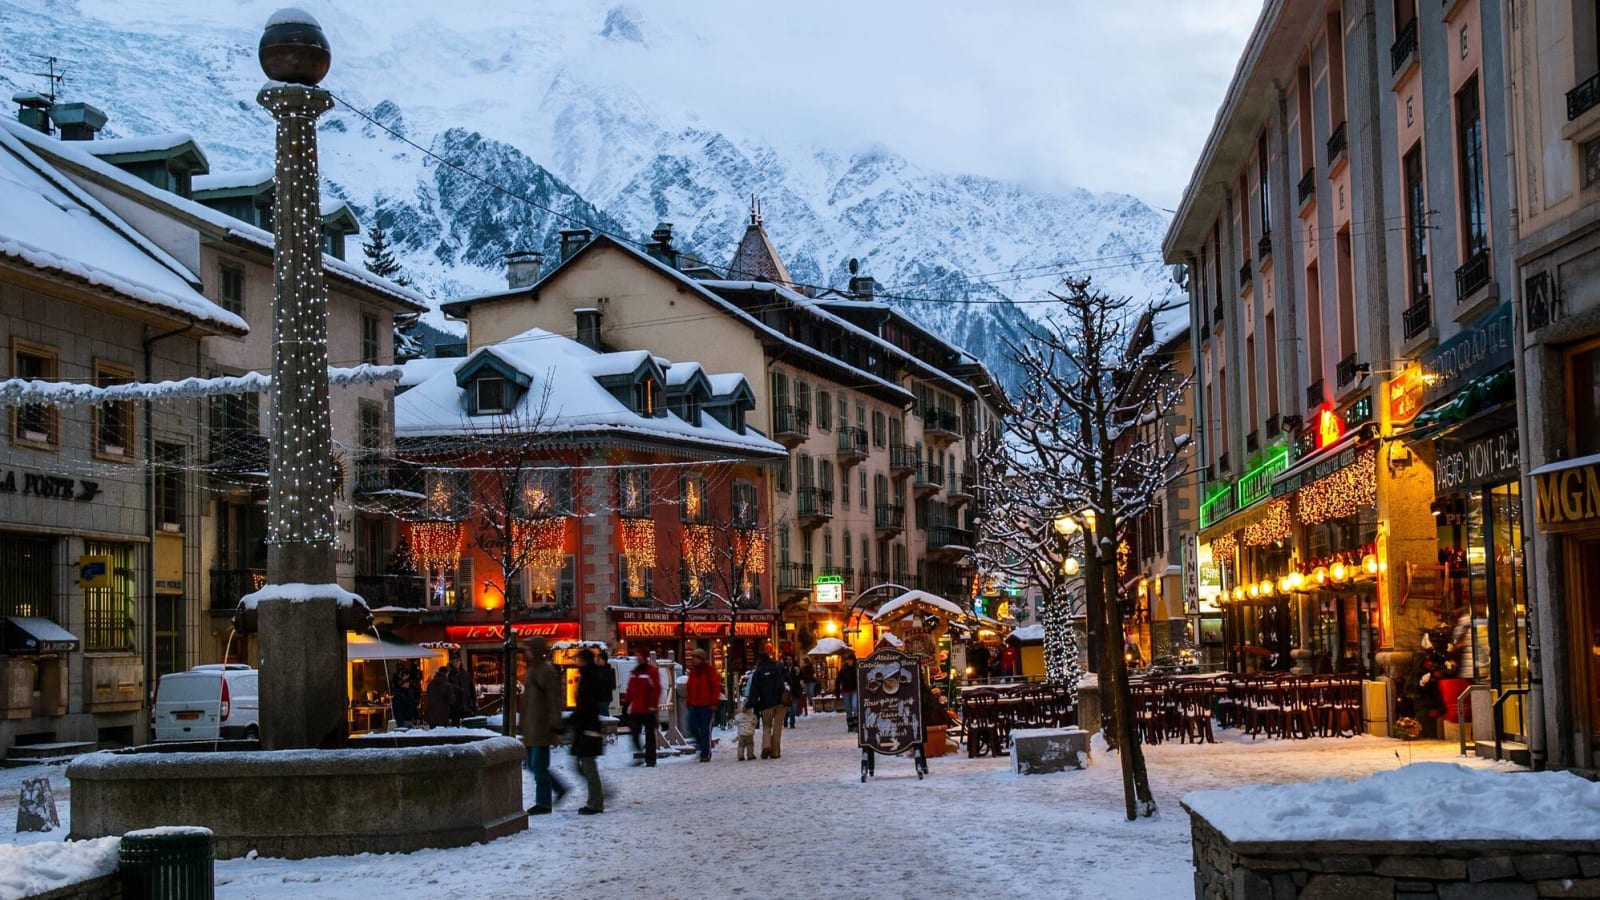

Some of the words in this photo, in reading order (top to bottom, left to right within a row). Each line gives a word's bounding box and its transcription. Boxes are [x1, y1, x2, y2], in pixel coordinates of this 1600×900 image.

[1437, 450, 1464, 491] PHOTO
[1468, 438, 1494, 480] MONT
[1498, 431, 1520, 471] BLA
[0, 470, 17, 492] A
[23, 473, 75, 499] POSTE
[1187, 536, 1197, 611] CINEMA
[467, 626, 480, 638] le
[486, 624, 559, 639] Nional
[625, 624, 675, 637] BRASSERIE
[725, 624, 769, 637] RSTAURANT
